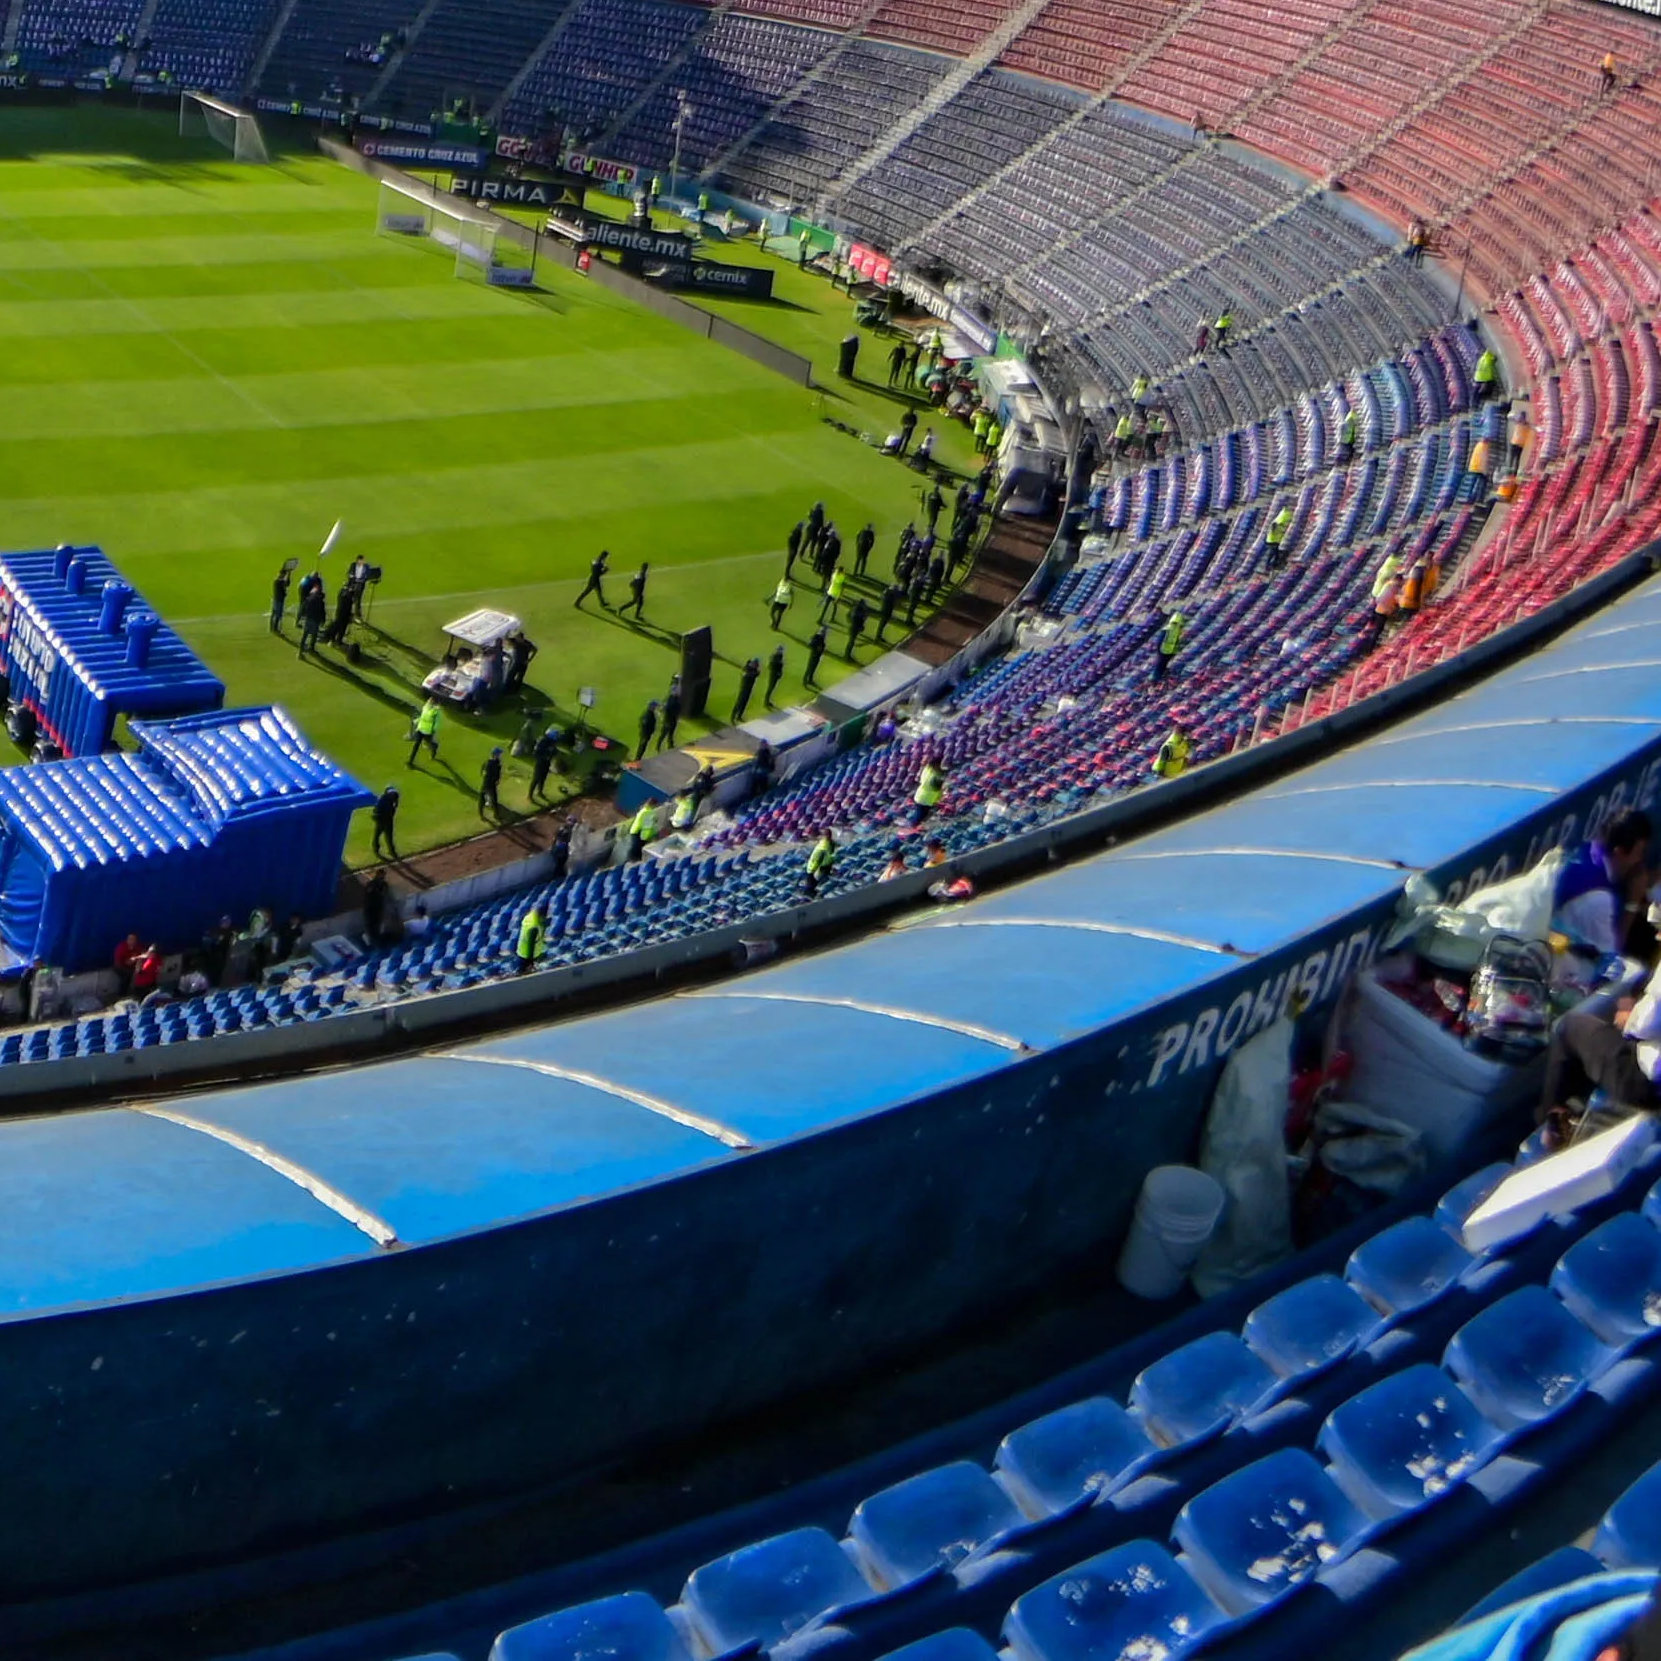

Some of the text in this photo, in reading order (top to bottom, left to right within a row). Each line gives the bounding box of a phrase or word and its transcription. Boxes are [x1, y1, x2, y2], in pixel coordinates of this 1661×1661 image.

[377, 144, 479, 165] CEMENTO CRUZ AZUL
[450, 179, 546, 203] PIRMA
[588, 223, 687, 259] aliente.mx
[707, 269, 747, 286] cemix
